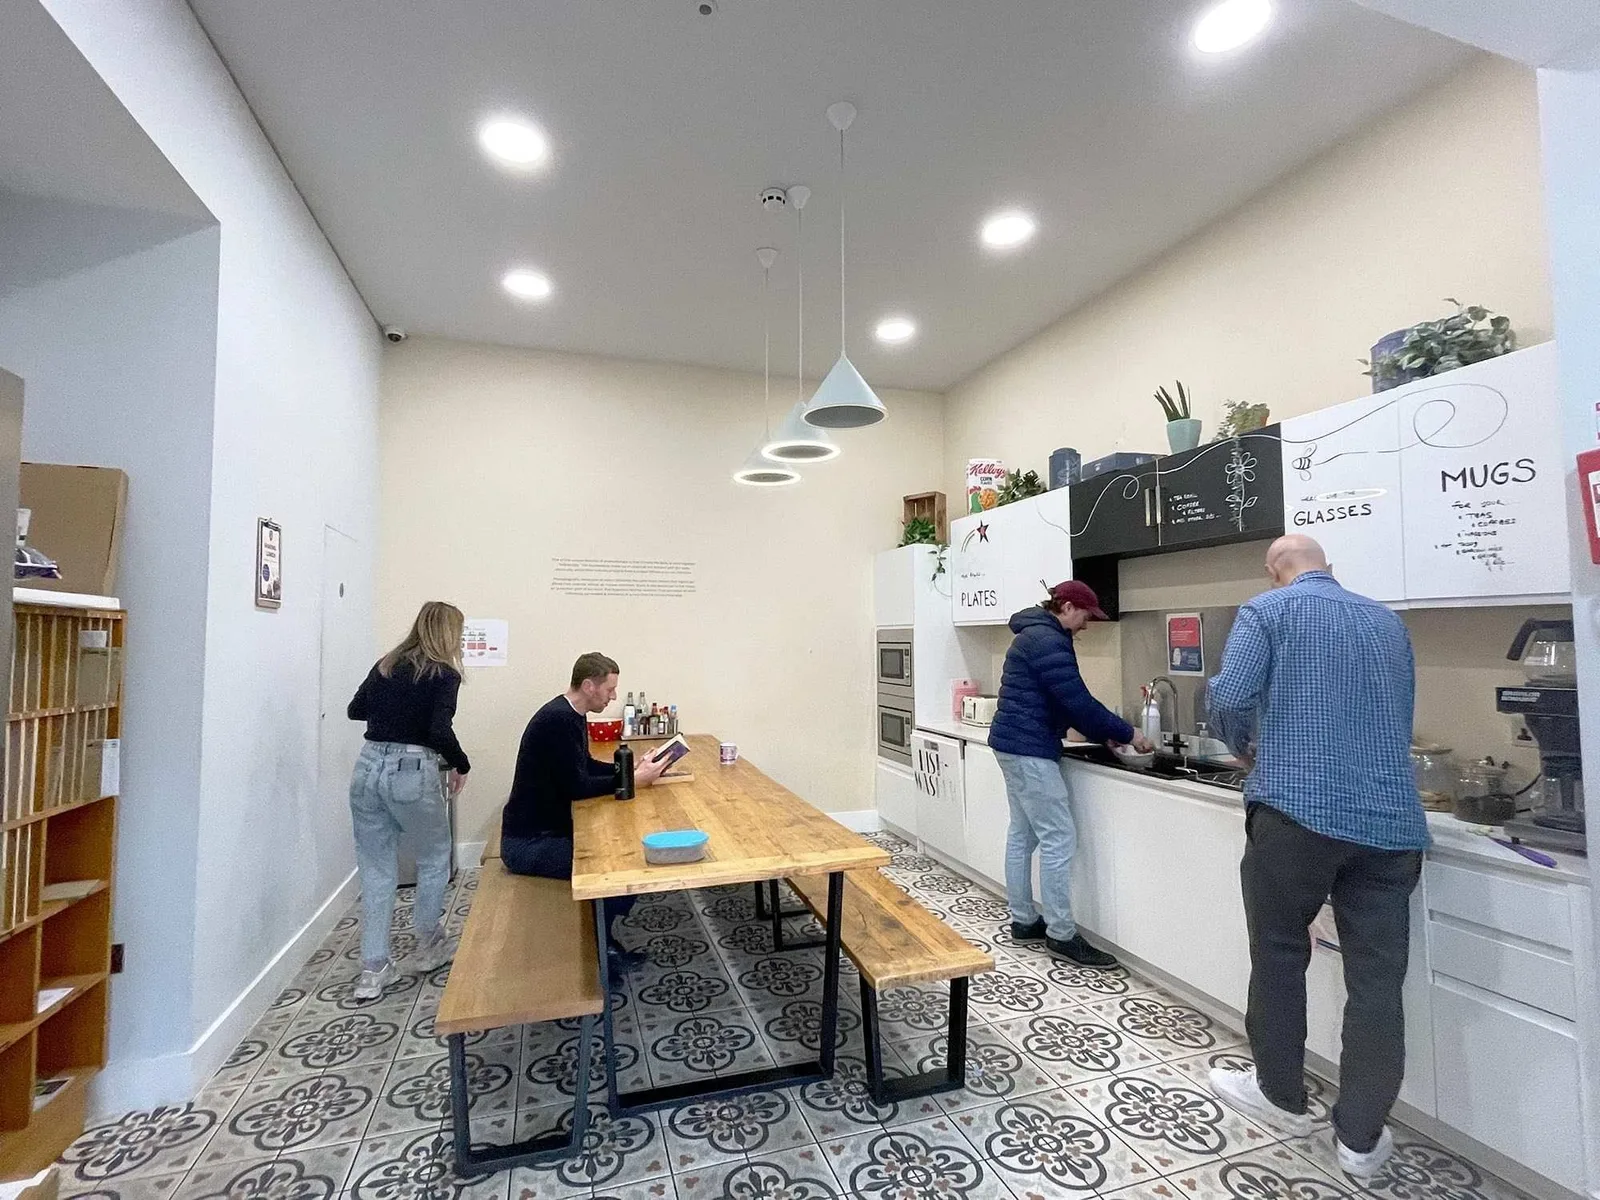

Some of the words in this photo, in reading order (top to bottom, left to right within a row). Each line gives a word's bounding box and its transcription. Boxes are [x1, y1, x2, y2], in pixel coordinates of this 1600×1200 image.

[1441, 458, 1536, 492] MUGS
[1293, 503, 1372, 526] GLASSES
[961, 589, 998, 607] PLATES
